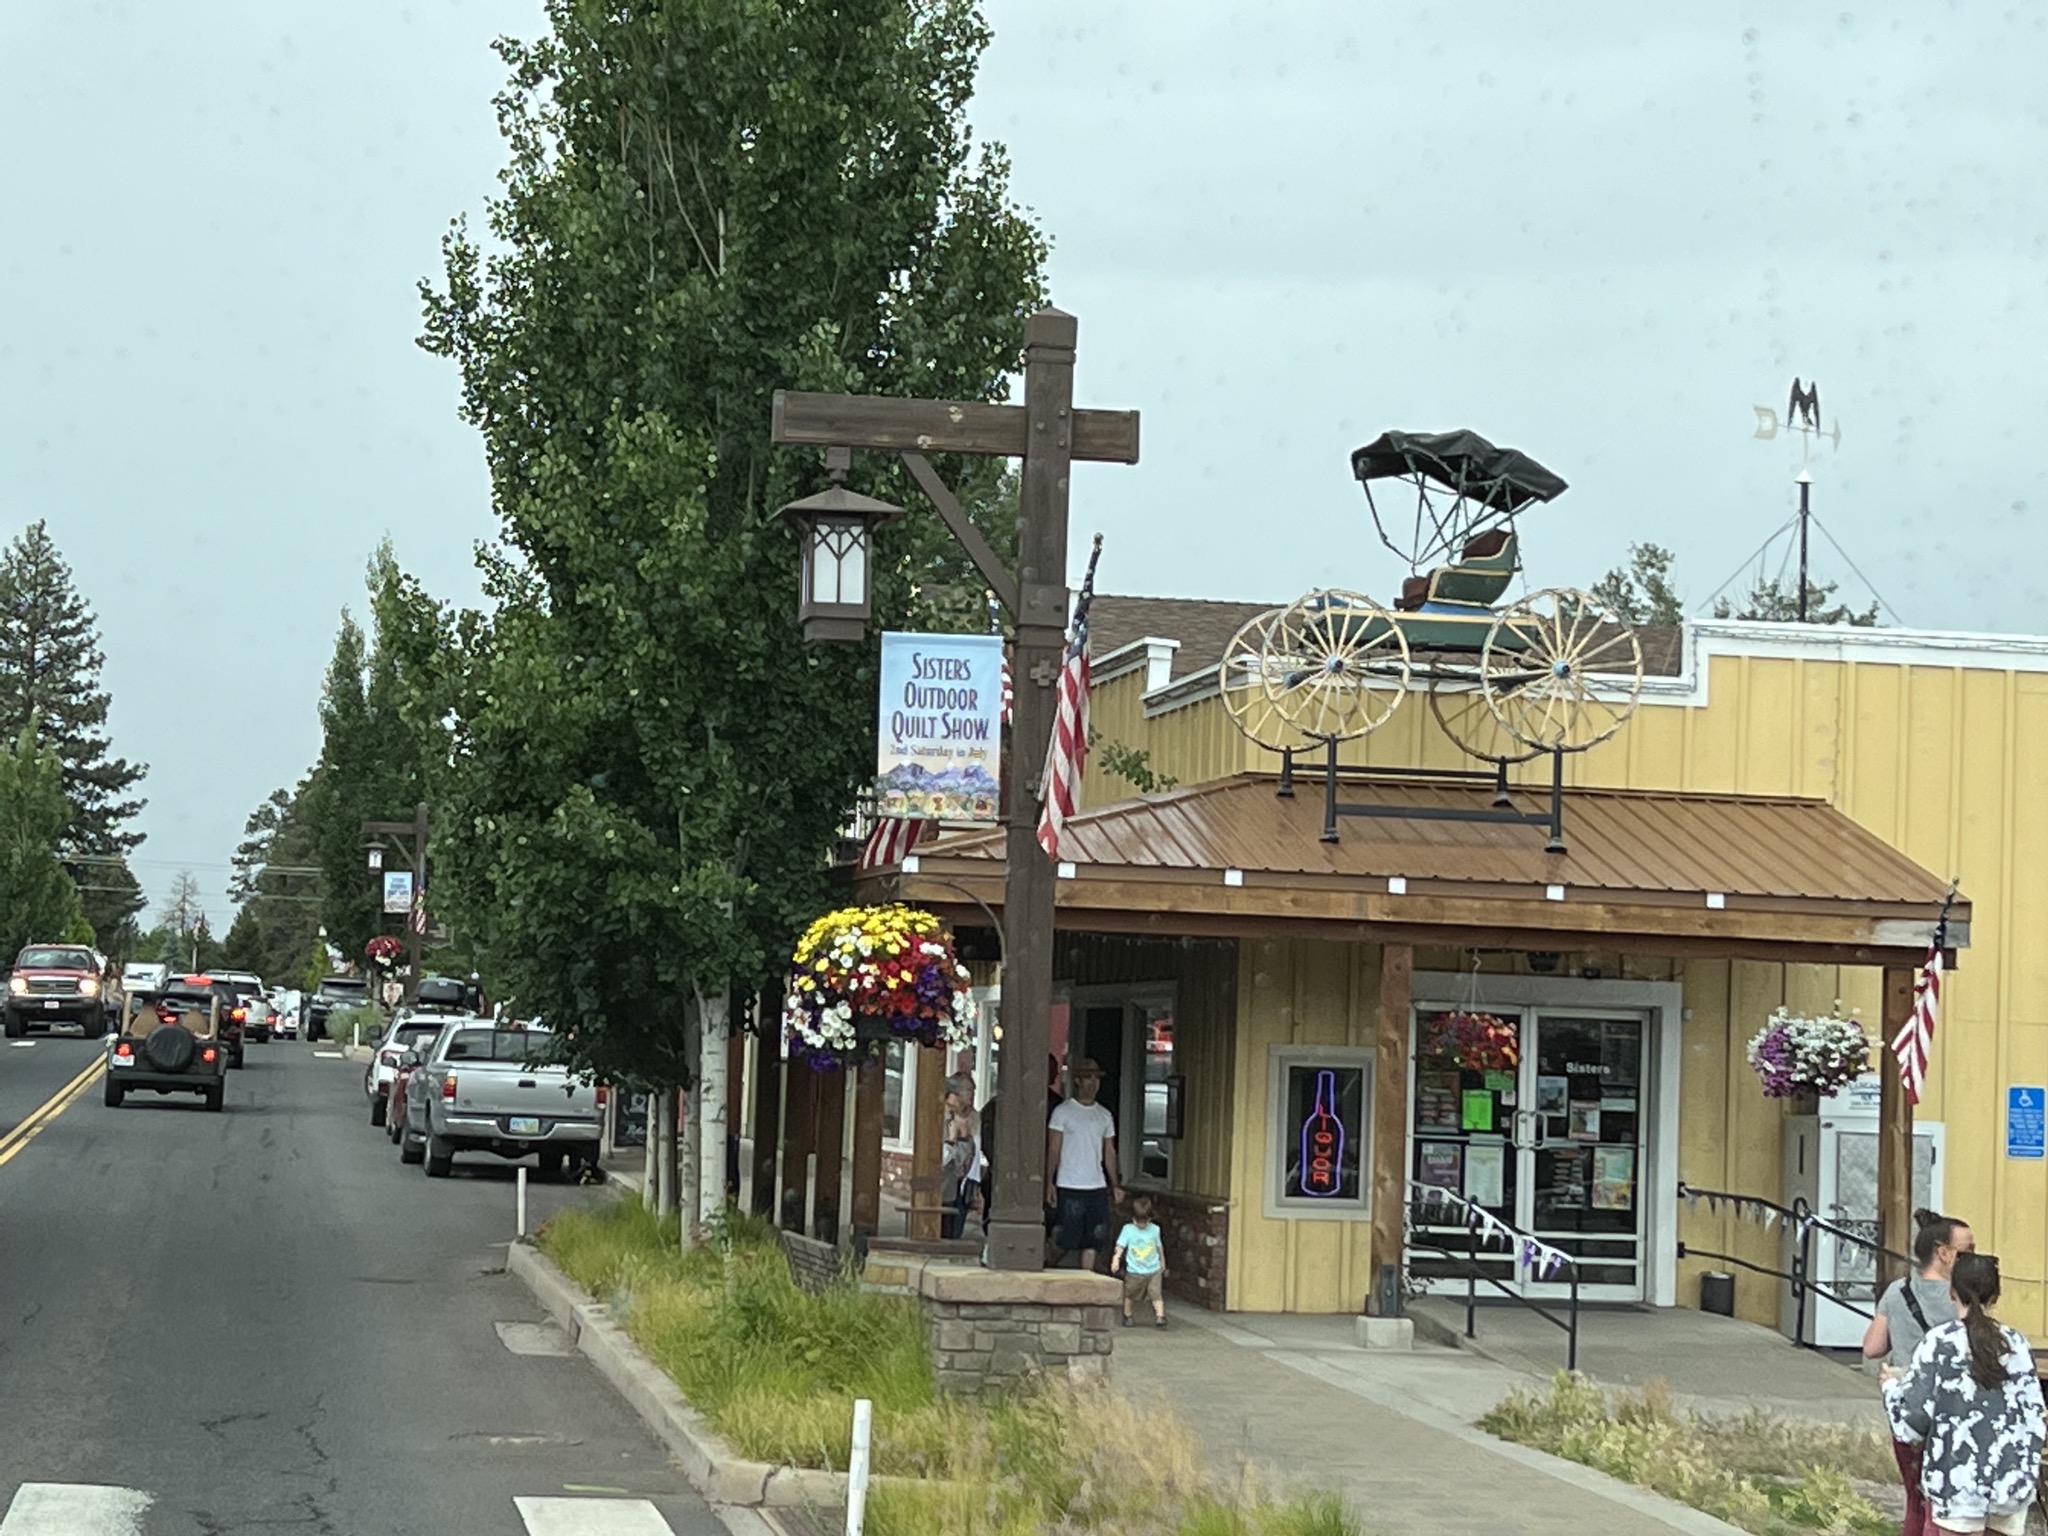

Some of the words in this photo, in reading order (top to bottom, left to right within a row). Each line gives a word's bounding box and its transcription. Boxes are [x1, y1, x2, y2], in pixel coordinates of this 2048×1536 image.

[912, 652, 972, 681] SISTERS
[904, 681, 978, 711] OUTDOOR
[891, 710, 937, 743] QUILT
[941, 712, 989, 741] SHOW
[890, 744, 908, 756] 2nd
[910, 744, 953, 760] Saturday
[968, 746, 988, 761] July
[1565, 1061, 1611, 1074] Sisters
[1312, 1103, 1333, 1186] LIQUOR
